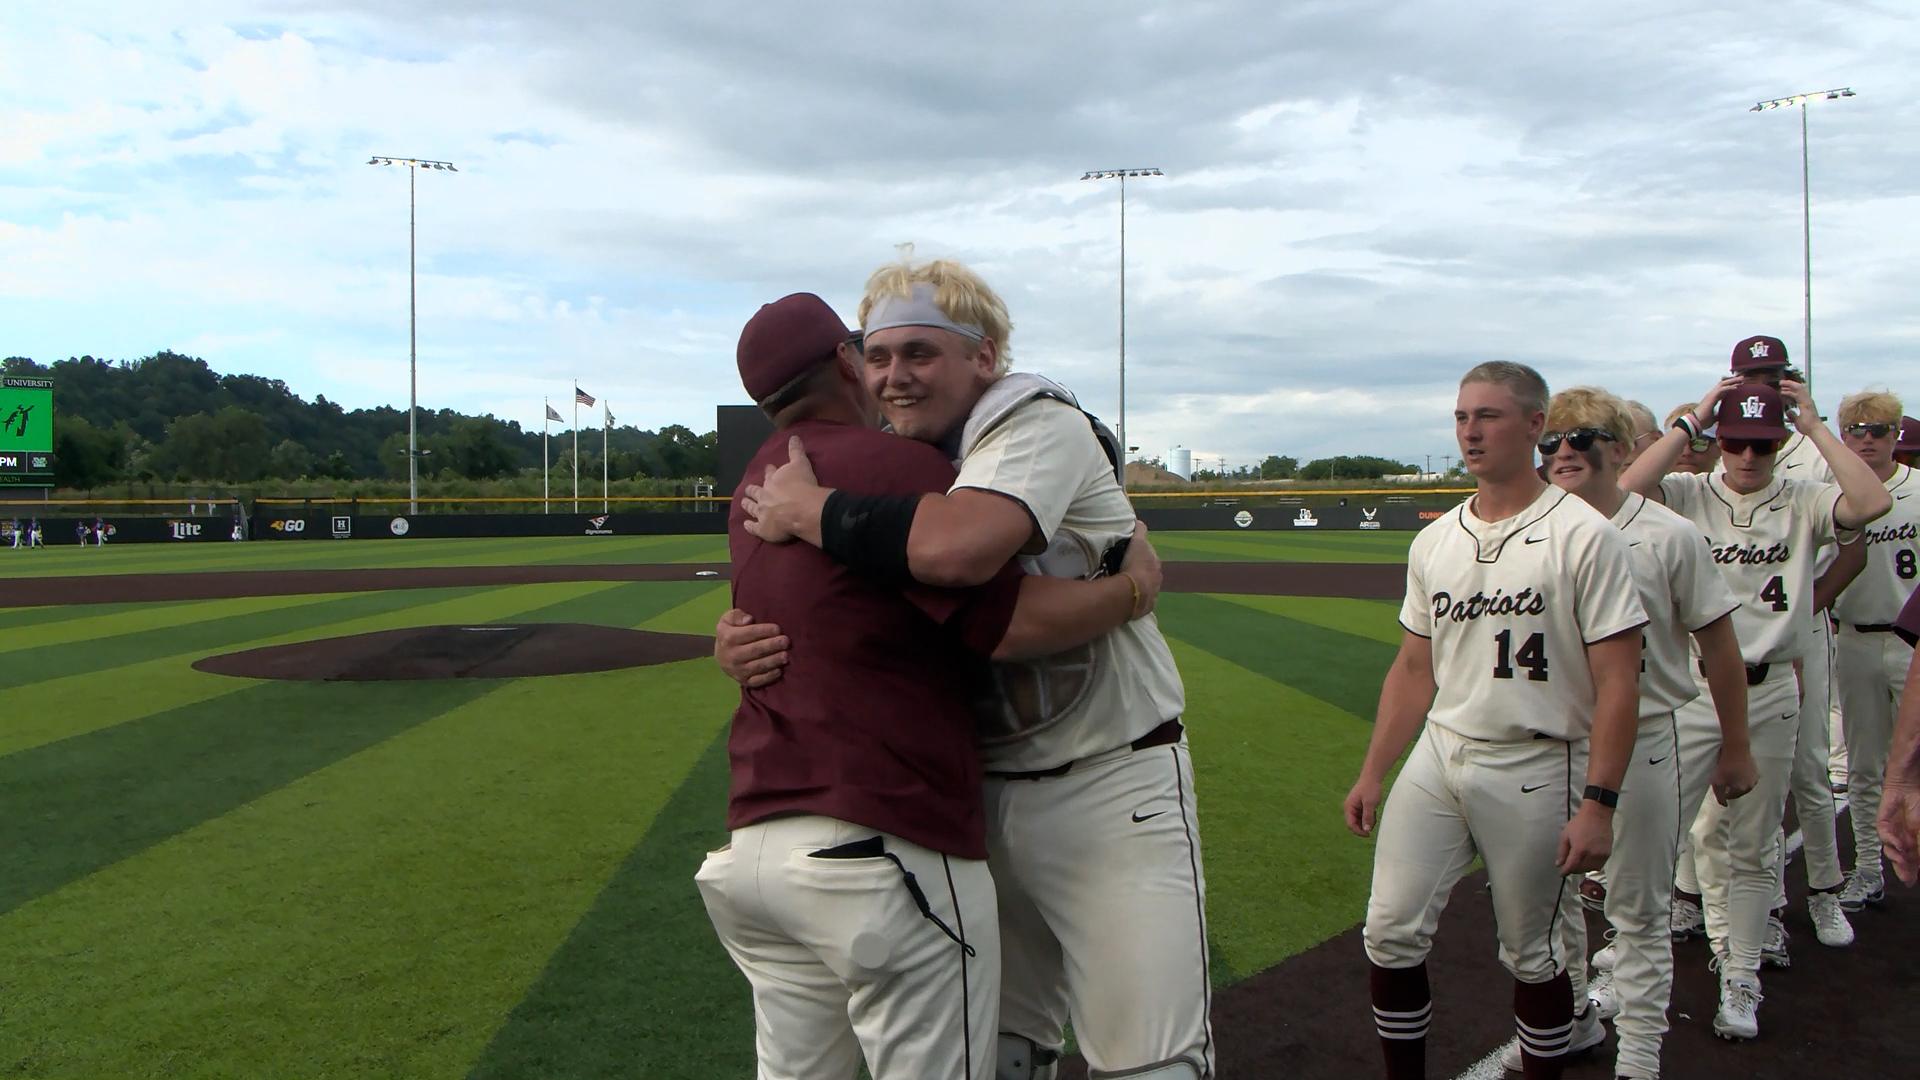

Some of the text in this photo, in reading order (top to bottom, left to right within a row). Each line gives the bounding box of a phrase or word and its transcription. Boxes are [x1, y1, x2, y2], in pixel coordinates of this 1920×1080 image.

[7, 379, 54, 388] UNIVERSITY
[0, 457, 17, 467] PM
[172, 522, 202, 540] Lite
[284, 519, 305, 532] GO
[1704, 536, 1790, 565] atriots
[1895, 549, 1918, 580] 8
[1432, 586, 1546, 628] Patriots
[1759, 575, 1789, 612] 4
[1493, 628, 1549, 682] 14
